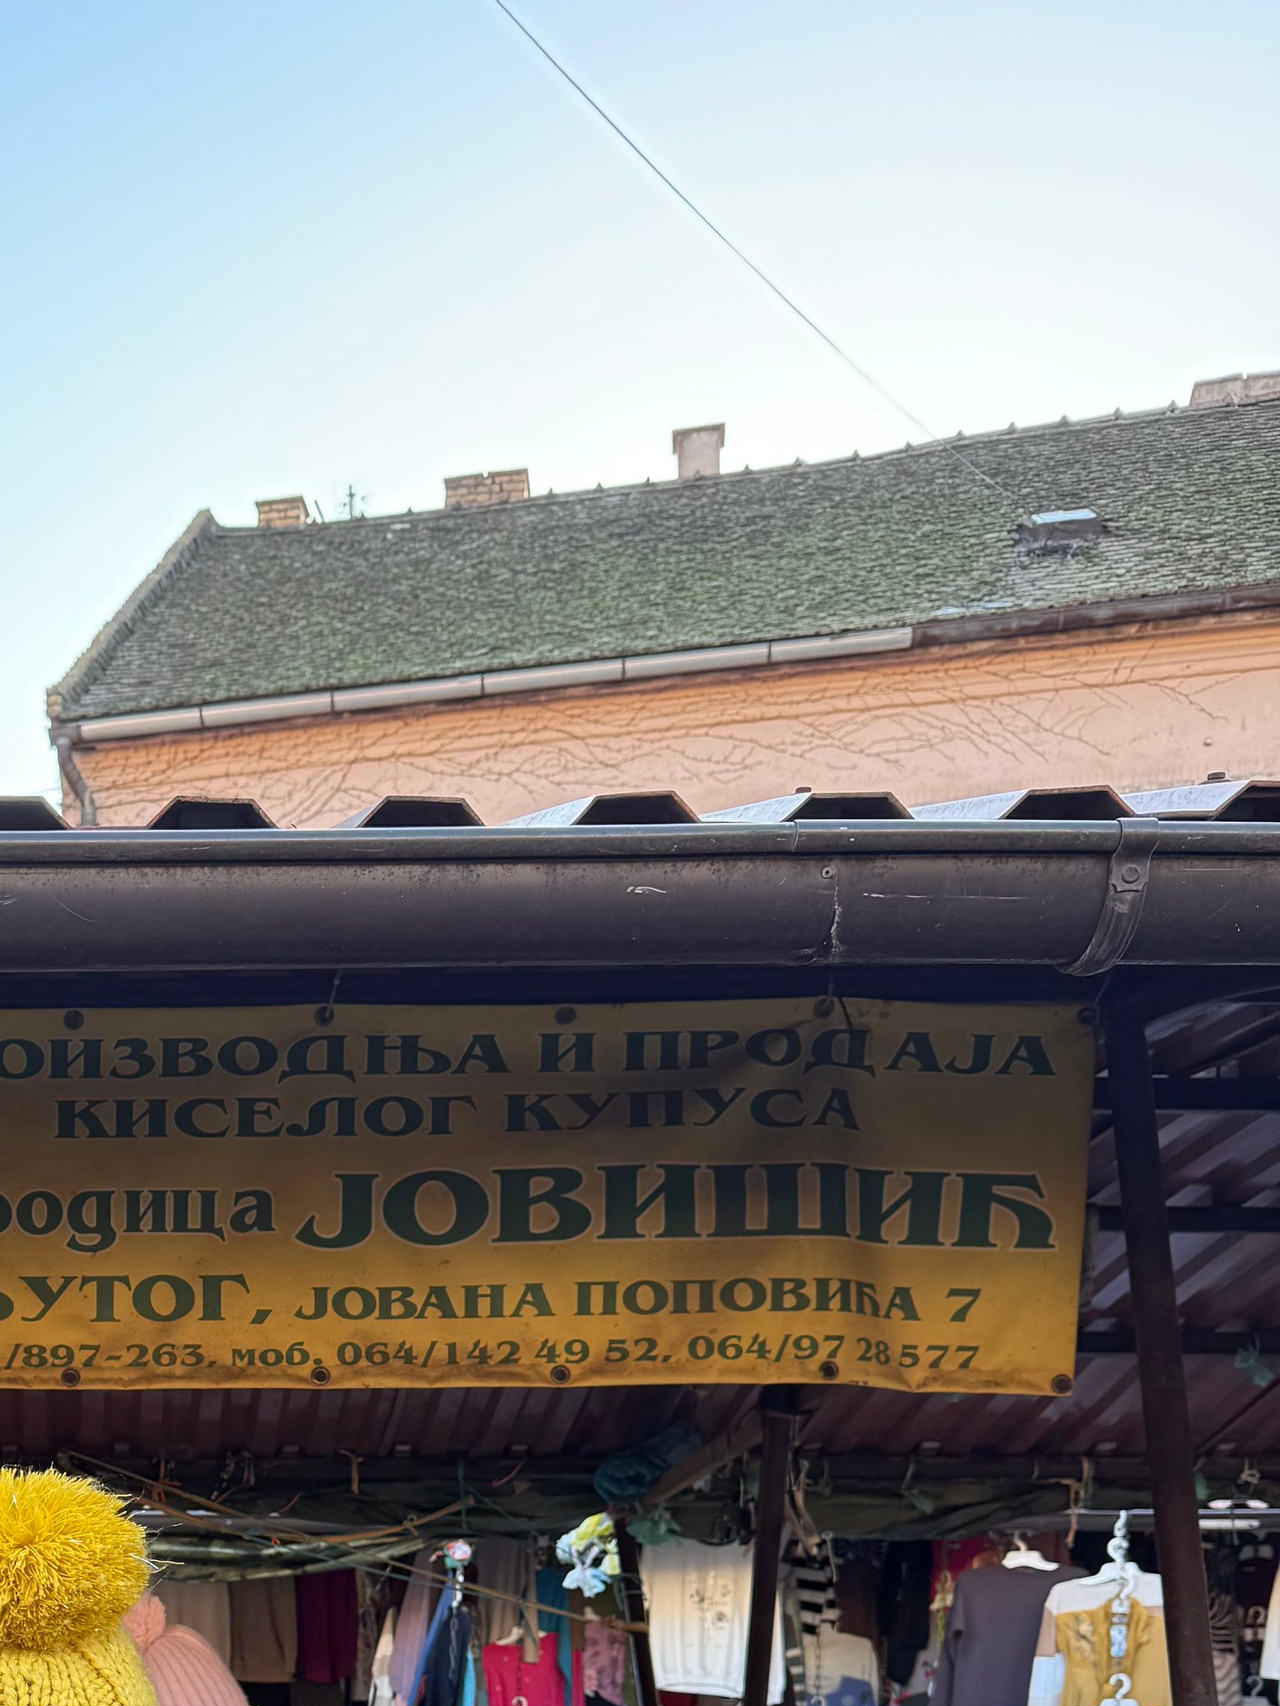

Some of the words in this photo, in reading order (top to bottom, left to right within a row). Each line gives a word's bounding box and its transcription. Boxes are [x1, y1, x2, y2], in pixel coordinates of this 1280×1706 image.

[536, 1031, 595, 1073] И
[622, 1027, 1057, 1079] ПРОДАЈА
[53, 1096, 477, 1140] КИСЕЛОГ
[503, 1086, 861, 1133] КУПУСА
[294, 1162, 1058, 1252] ЈОВИШИЋ
[294, 1282, 557, 1323] ЈОВАНА
[574, 1277, 920, 1323] ПОПОВИЋА
[945, 1287, 982, 1324] 7
[231, 1341, 324, 1367] моб.
[335, 1340, 520, 1369] 064/142
[534, 1337, 591, 1365] 49
[605, 1336, 673, 1364] 52,
[687, 1333, 846, 1363] 064/97
[855, 1336, 890, 1367] 28
[898, 1344, 980, 1369] 577
